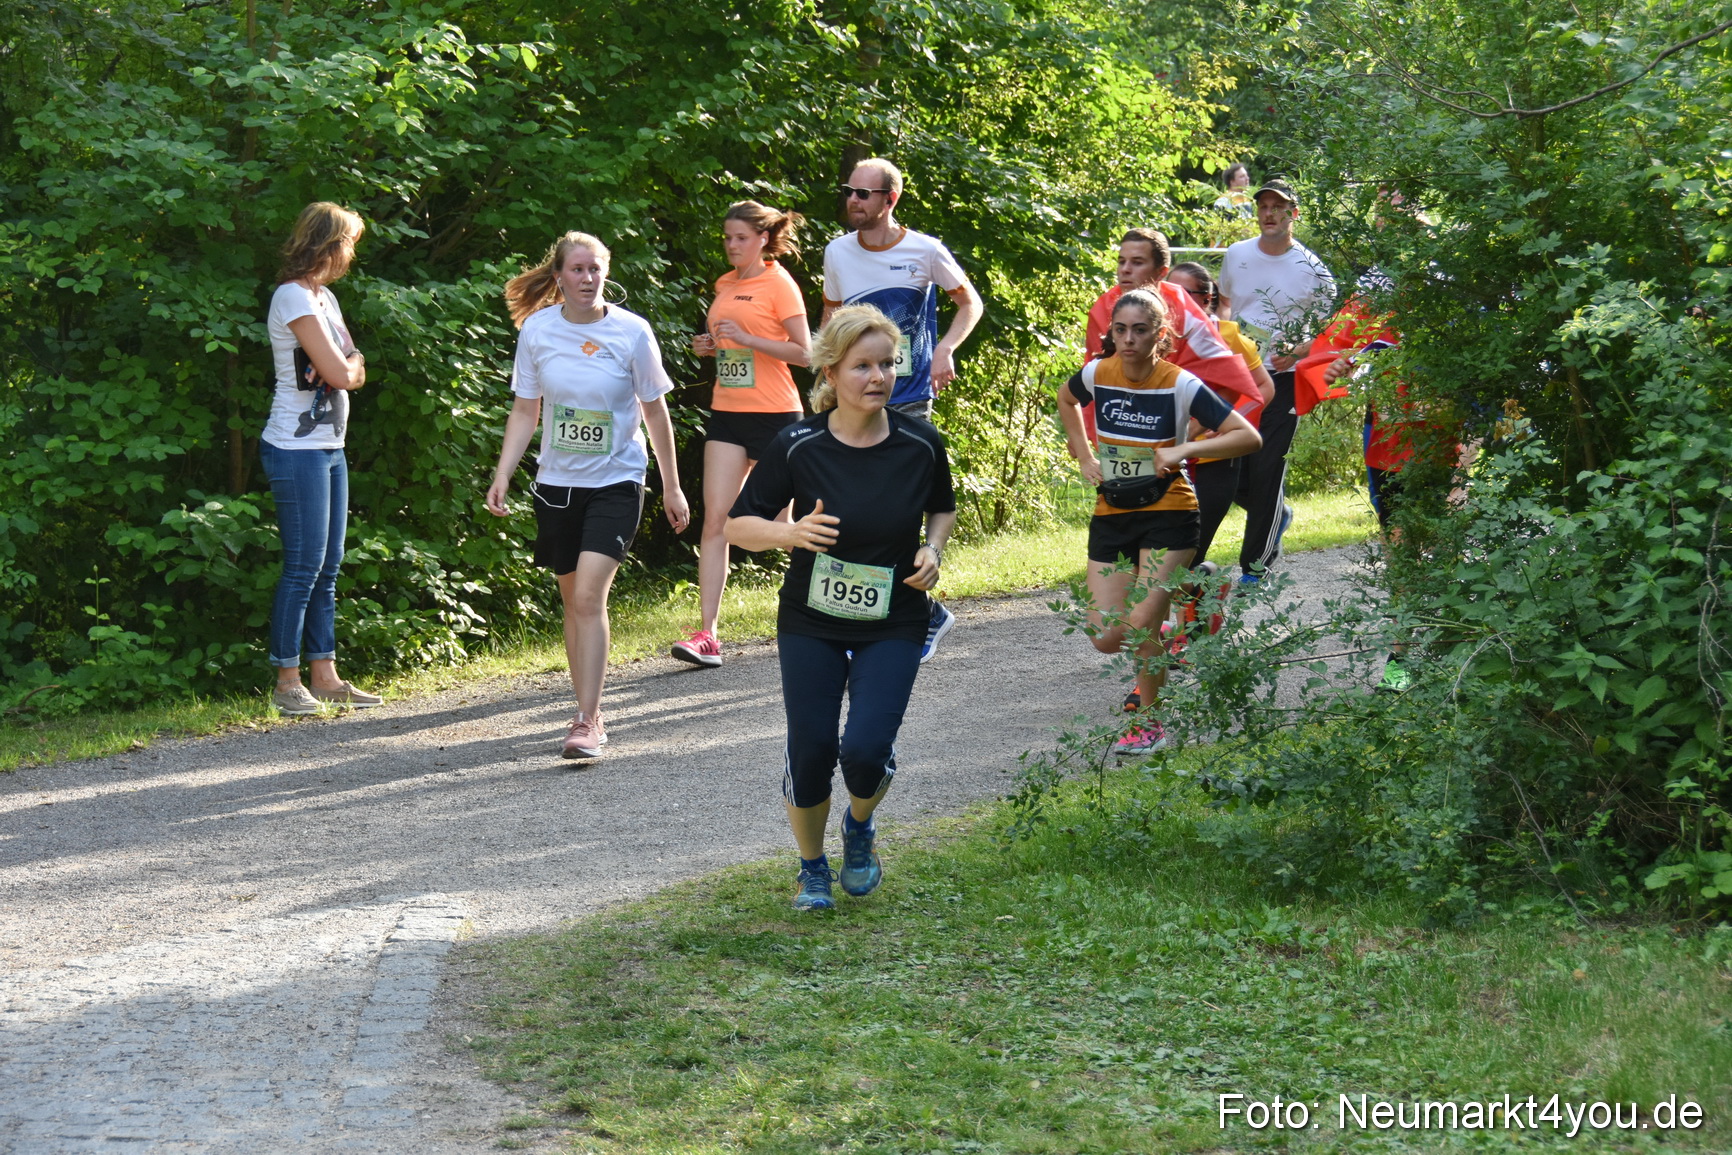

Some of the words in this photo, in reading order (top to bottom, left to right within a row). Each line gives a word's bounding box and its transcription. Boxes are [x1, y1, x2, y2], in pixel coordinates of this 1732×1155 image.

[718, 362, 748, 377] 2303
[1110, 407, 1162, 424] Fischer
[559, 422, 604, 442] 1369
[1114, 420, 1157, 431] AUTOMOBILE
[1109, 459, 1142, 476] 787
[820, 576, 879, 608] 1959
[825, 597, 844, 608] Faltus
[844, 603, 868, 613] Gudrun
